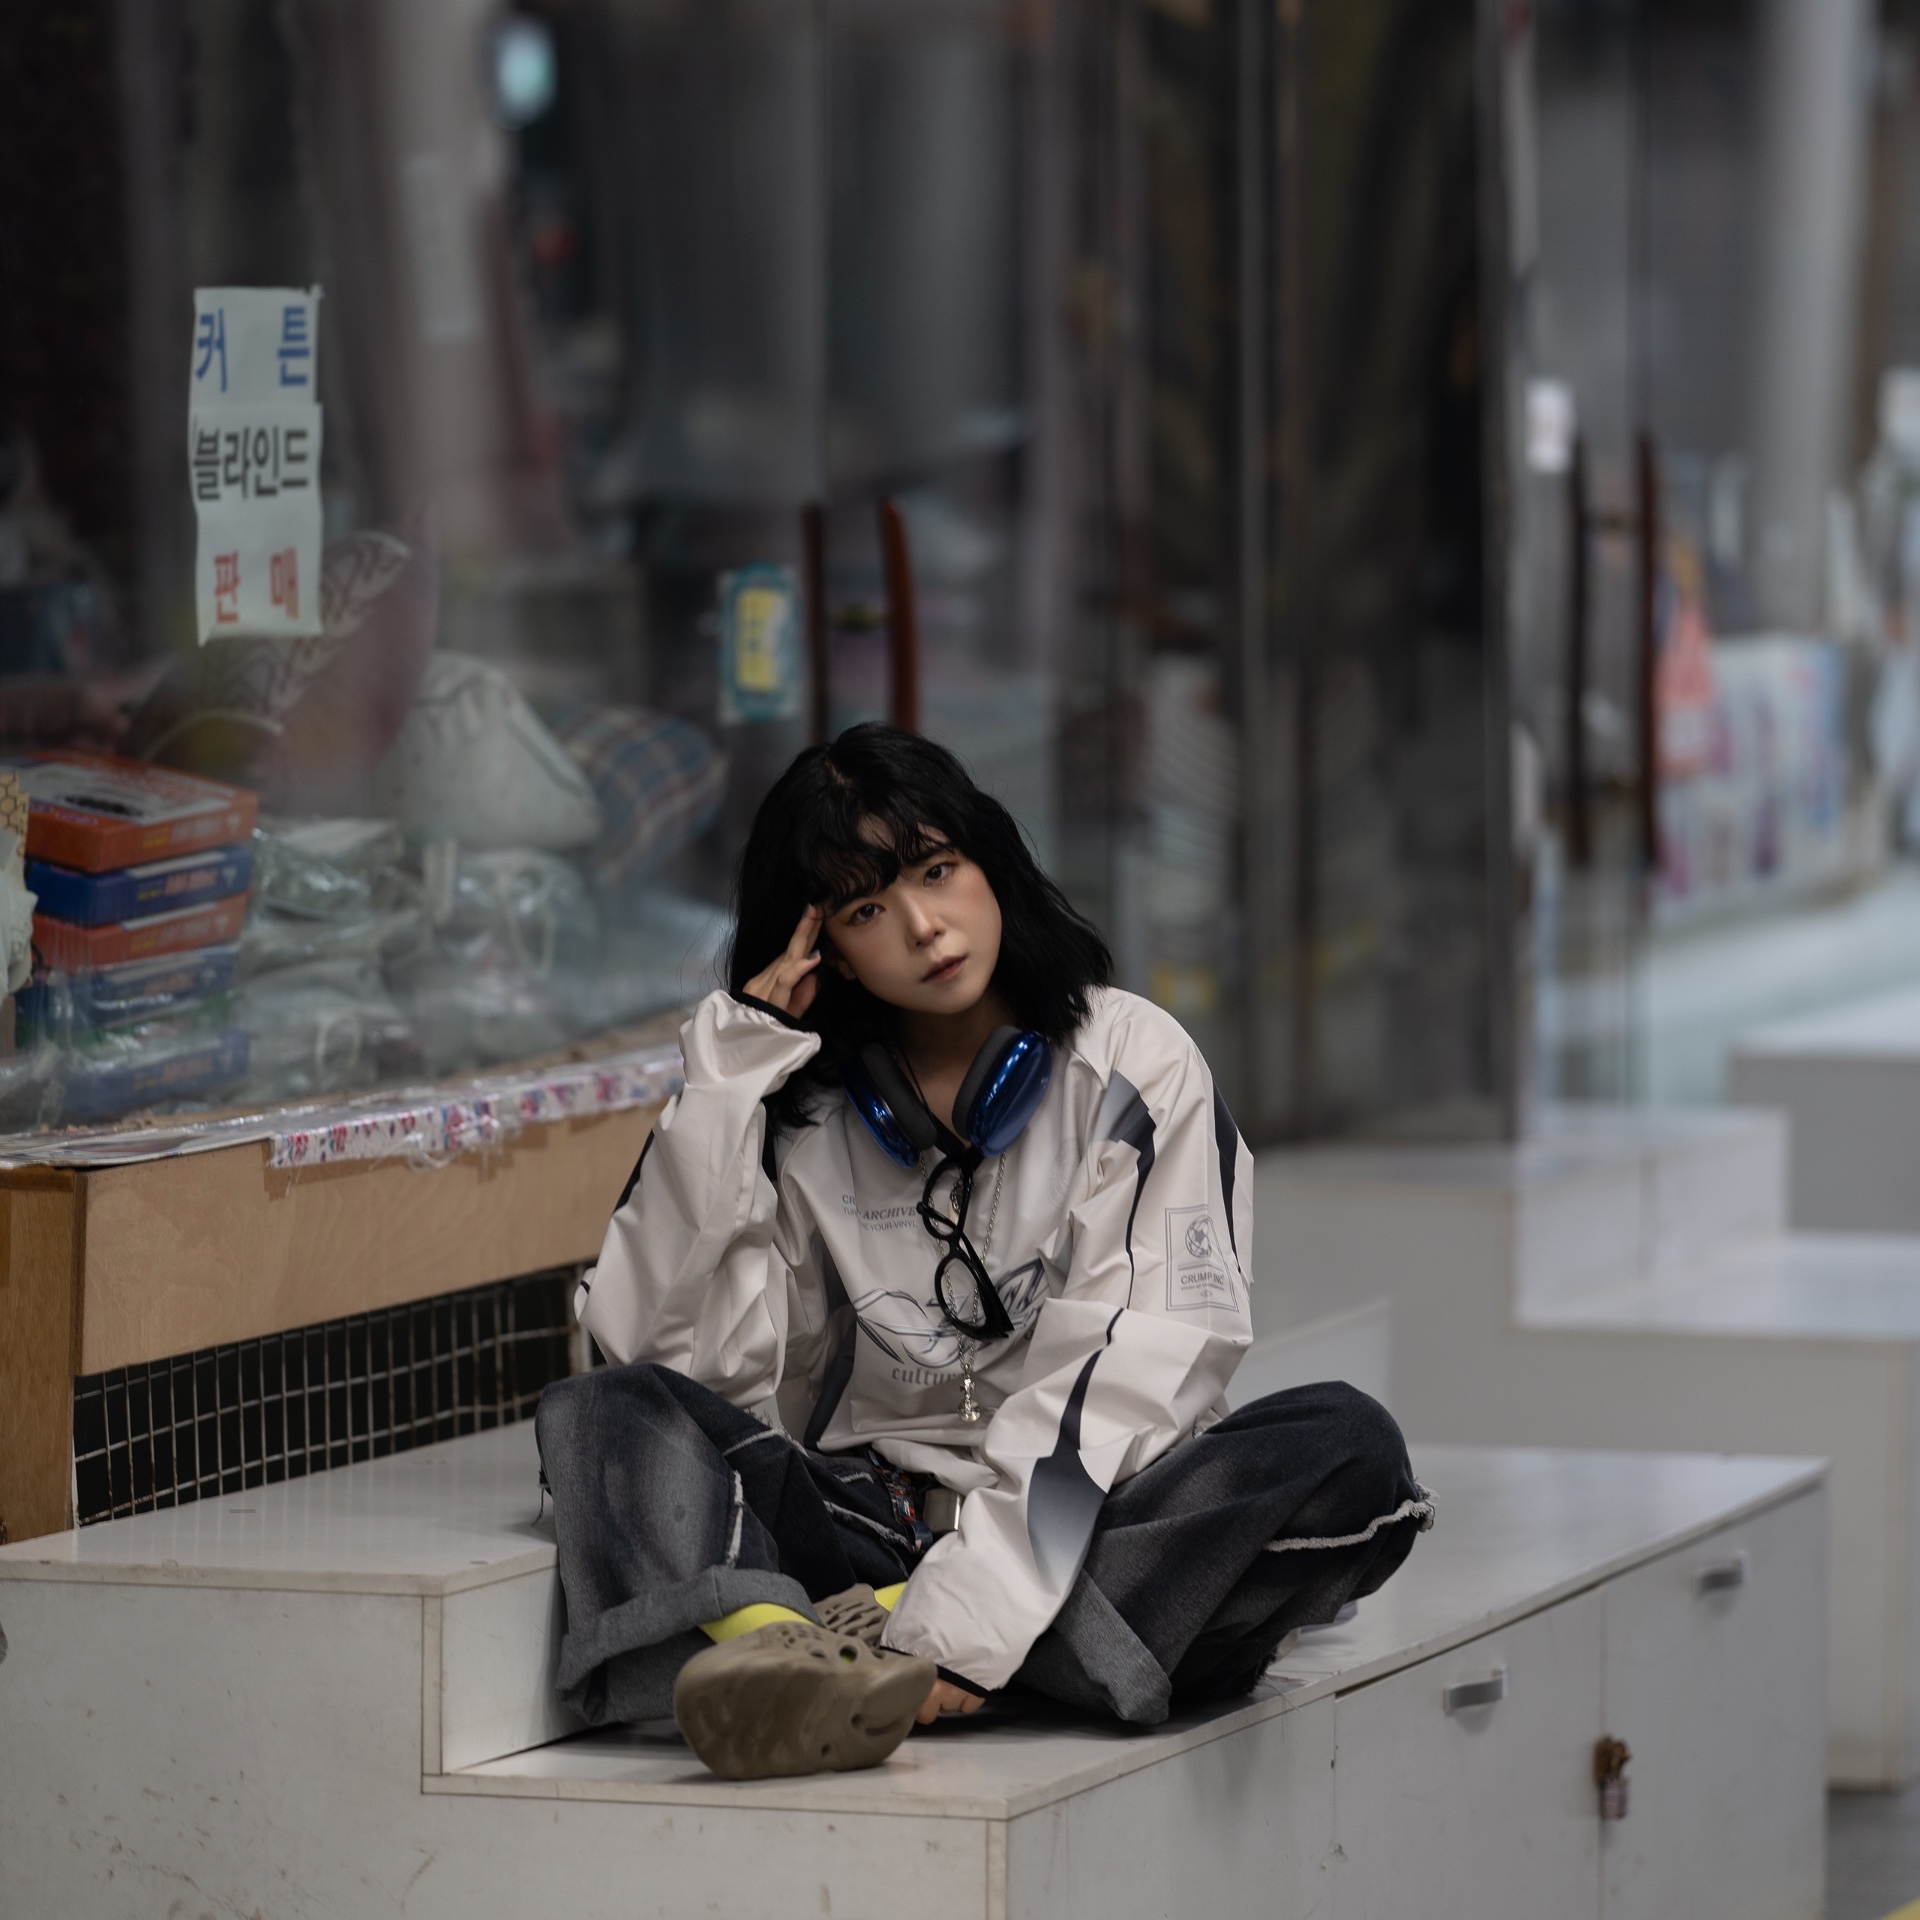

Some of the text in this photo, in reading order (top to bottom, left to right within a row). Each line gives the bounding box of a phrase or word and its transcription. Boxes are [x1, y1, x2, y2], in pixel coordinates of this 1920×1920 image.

[196, 306, 310, 393] 커튼
[193, 426, 308, 501] 블라인드
[213, 547, 299, 624] 판매
[863, 1205, 917, 1220] ARCHIVE
[1181, 1272, 1213, 1284] CRUMP
